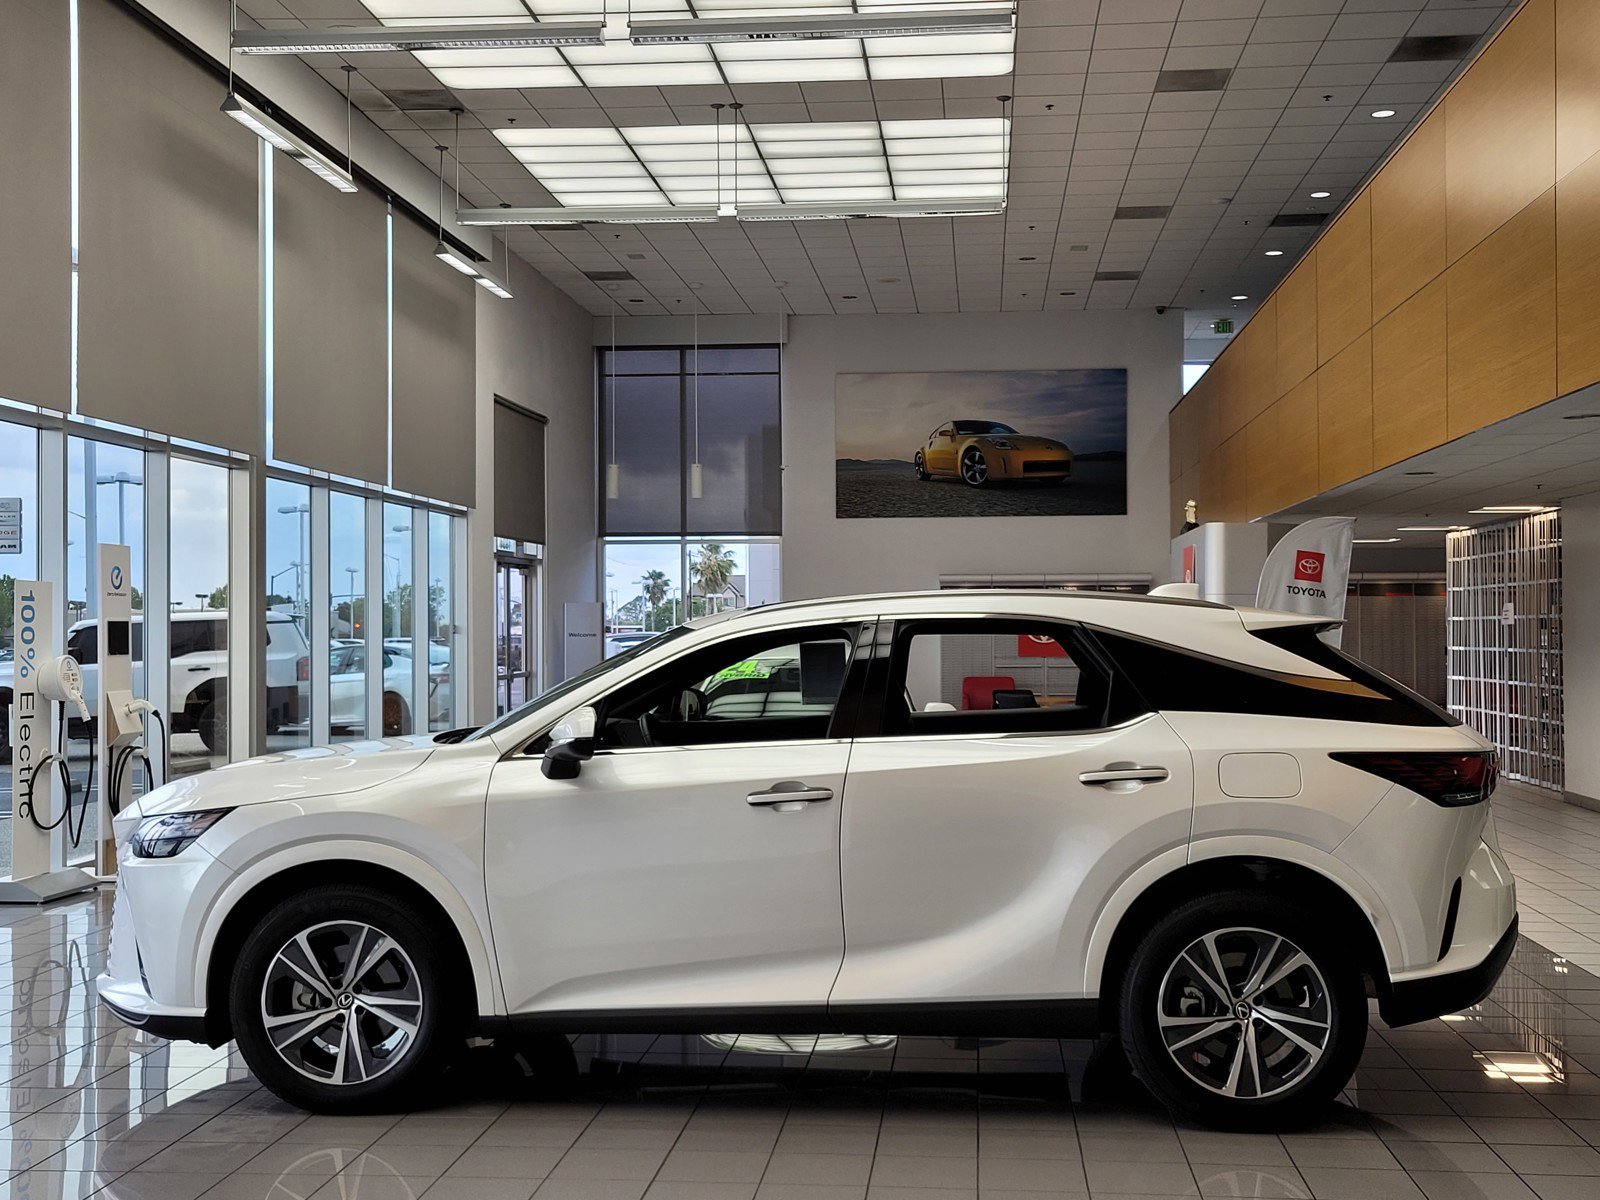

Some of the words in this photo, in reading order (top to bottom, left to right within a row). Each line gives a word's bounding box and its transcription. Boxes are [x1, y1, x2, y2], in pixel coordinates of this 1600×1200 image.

[20, 590, 36, 679] 100%
[1286, 585, 1327, 599] TOYOTA
[18, 692, 35, 819] Electric
